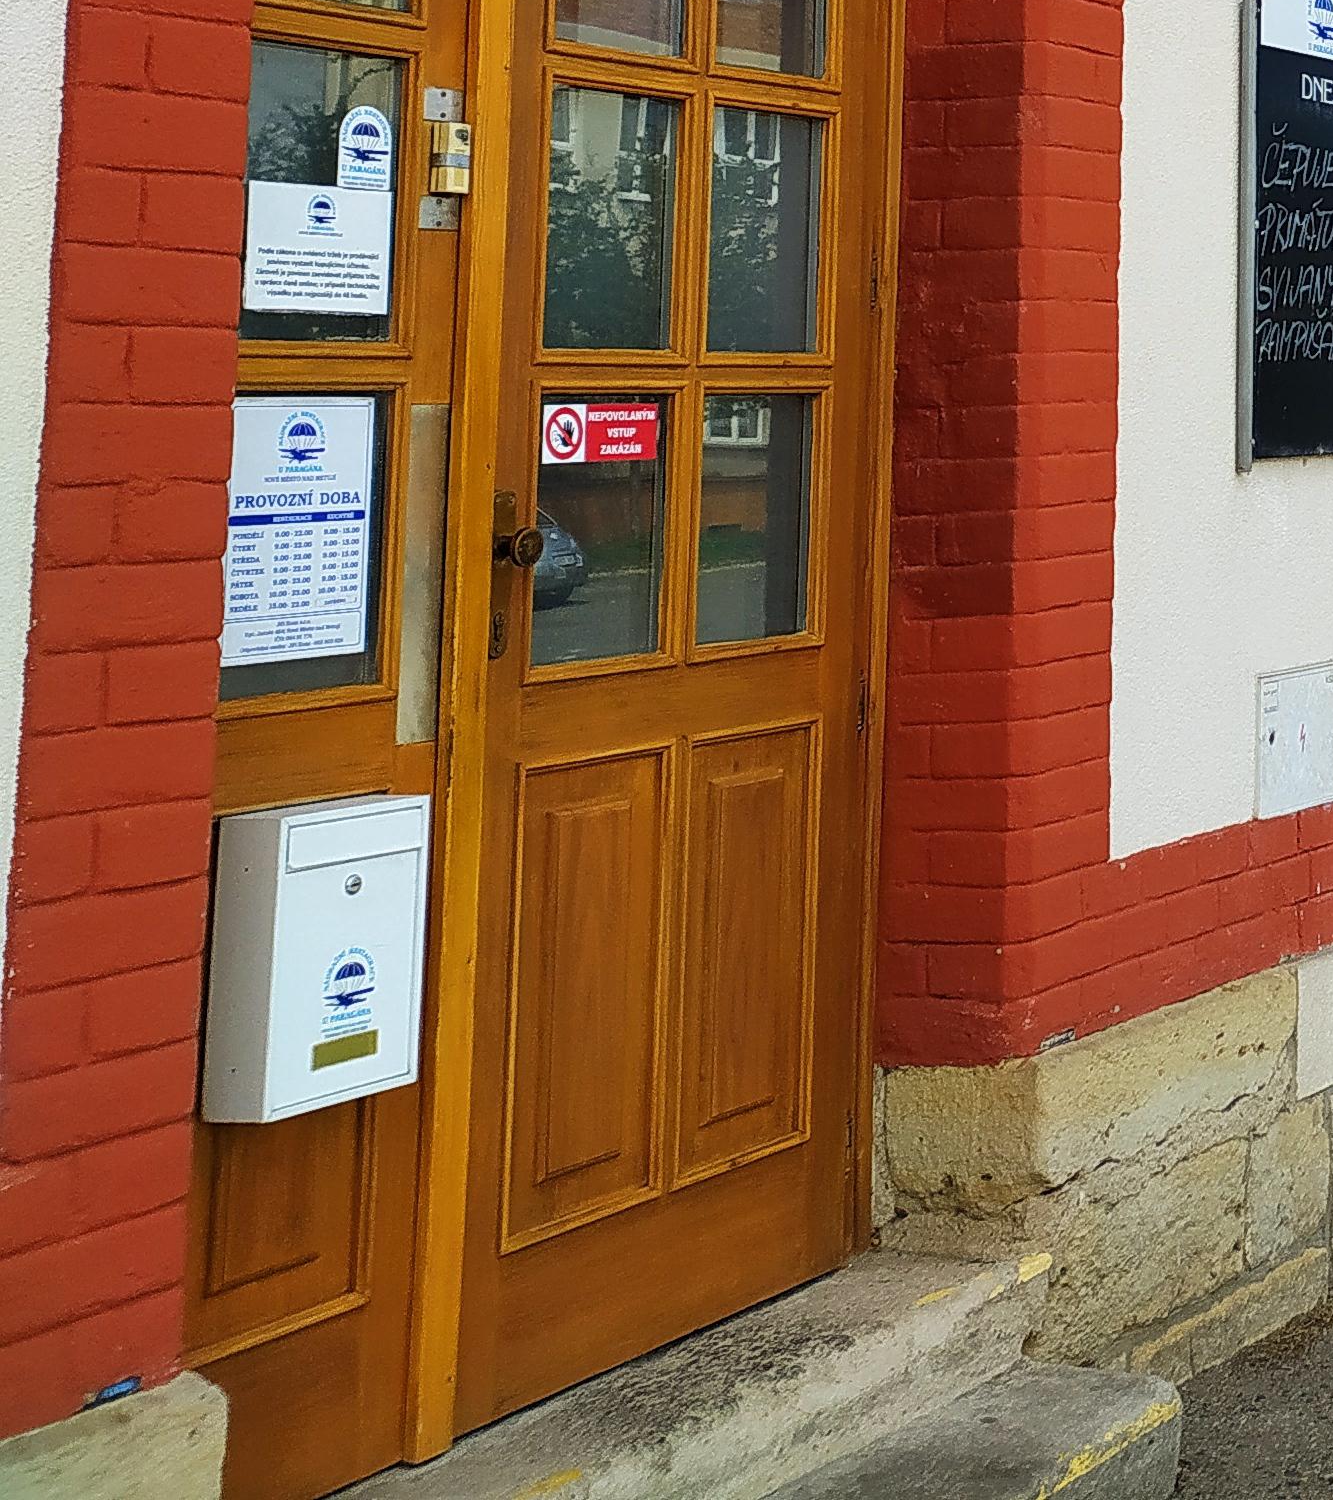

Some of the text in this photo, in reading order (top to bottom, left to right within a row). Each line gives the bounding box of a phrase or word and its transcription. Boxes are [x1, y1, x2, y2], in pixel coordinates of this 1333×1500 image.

[349, 164, 386, 175] PARAGÁNA
[588, 408, 656, 421] NEPOVOLANÝM
[607, 428, 636, 438] VSTUP
[600, 442, 642, 455] ZAKÁZÁN
[234, 489, 361, 509] PROVOZNÍ DOBA
